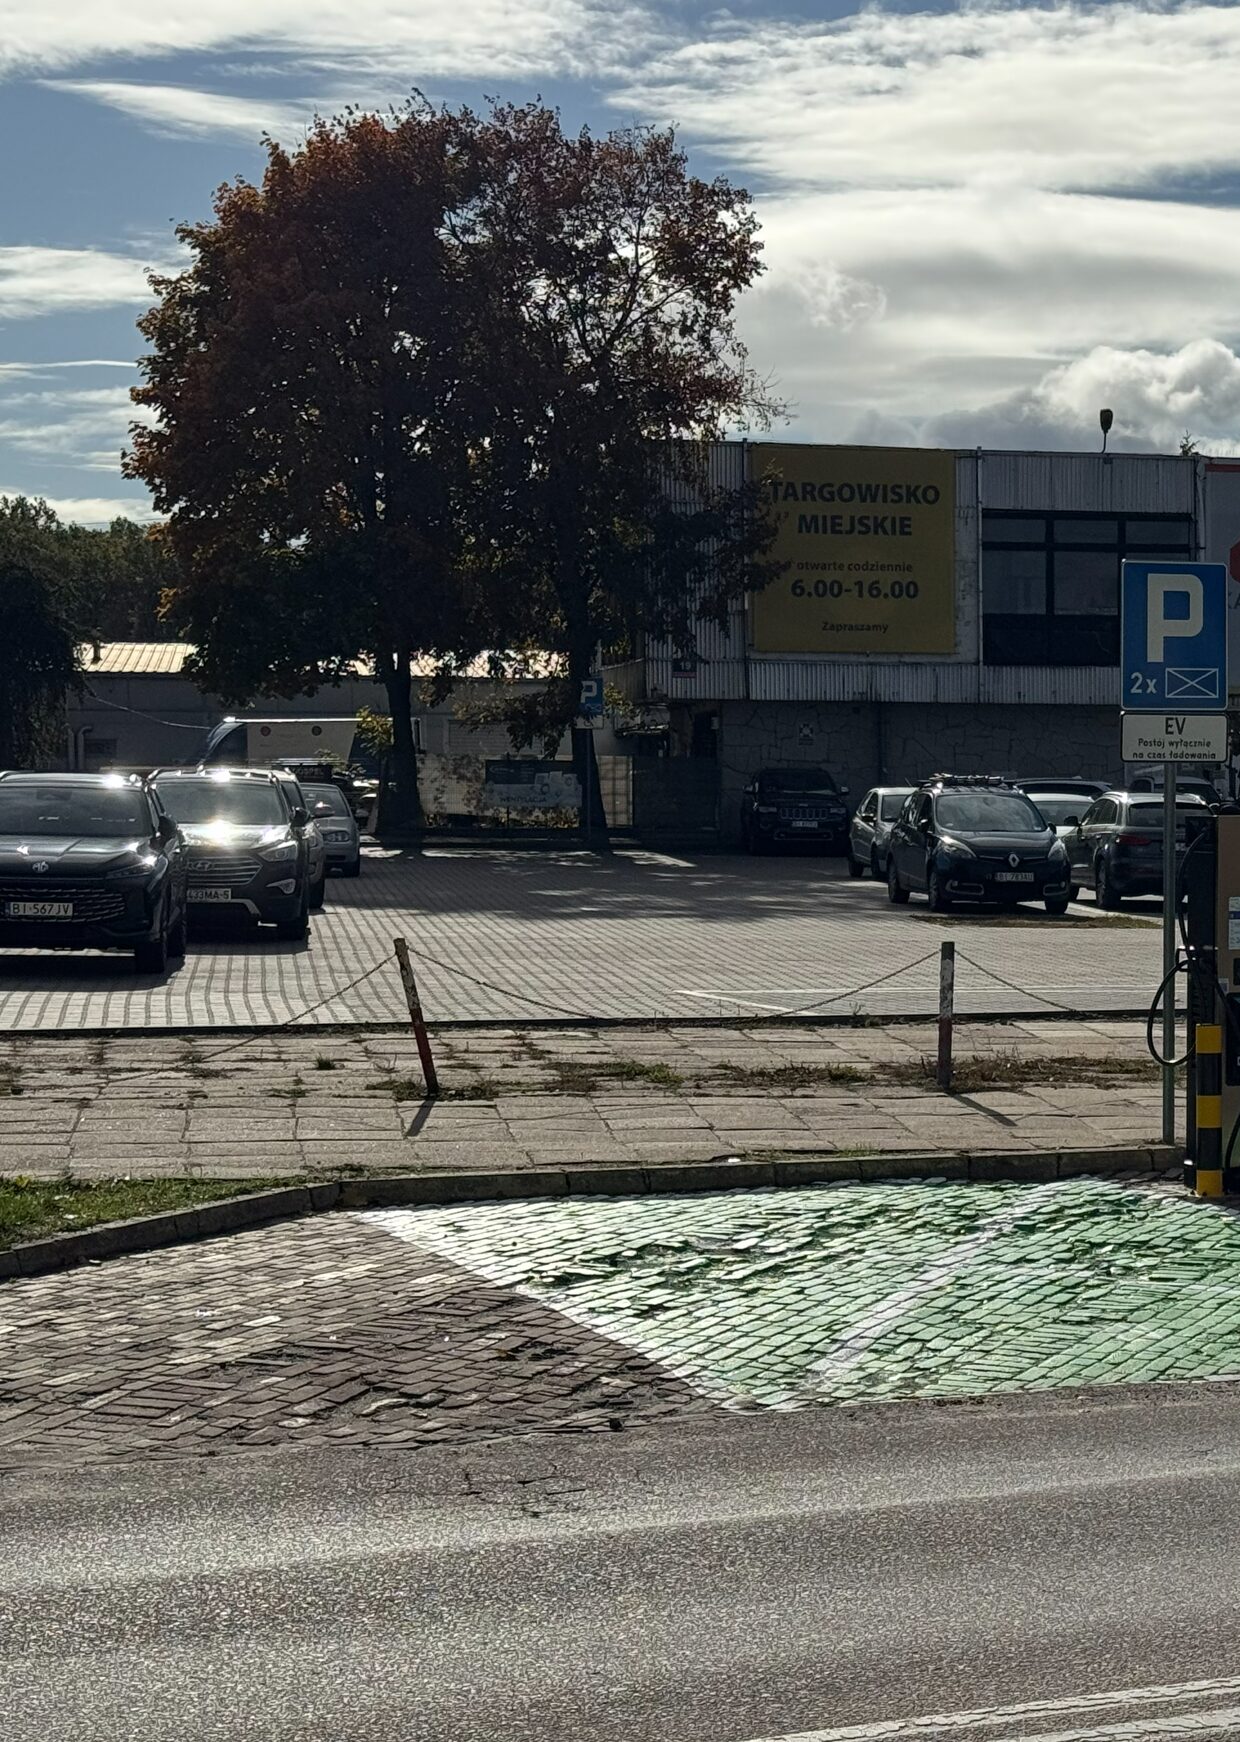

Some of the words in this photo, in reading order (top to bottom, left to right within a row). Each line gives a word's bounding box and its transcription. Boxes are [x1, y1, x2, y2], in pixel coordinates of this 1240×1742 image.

[770, 481, 941, 505] TARGOWISKO
[797, 514, 913, 536] MIEJSKIE
[797, 561, 845, 571] otwarte
[848, 560, 913, 573] codziennie
[791, 579, 919, 599] 6.00-16.00
[1147, 573, 1204, 662] P
[821, 621, 889, 634] Zapraszamy
[580, 680, 598, 704] P
[1165, 717, 1186, 735] EV
[1138, 738, 1165, 749] Postój
[1168, 738, 1212, 749] wyłącznie
[1169, 750, 1216, 760] ładowania
[12, 903, 27, 914] BI
[33, 903, 69, 914] 567JV
